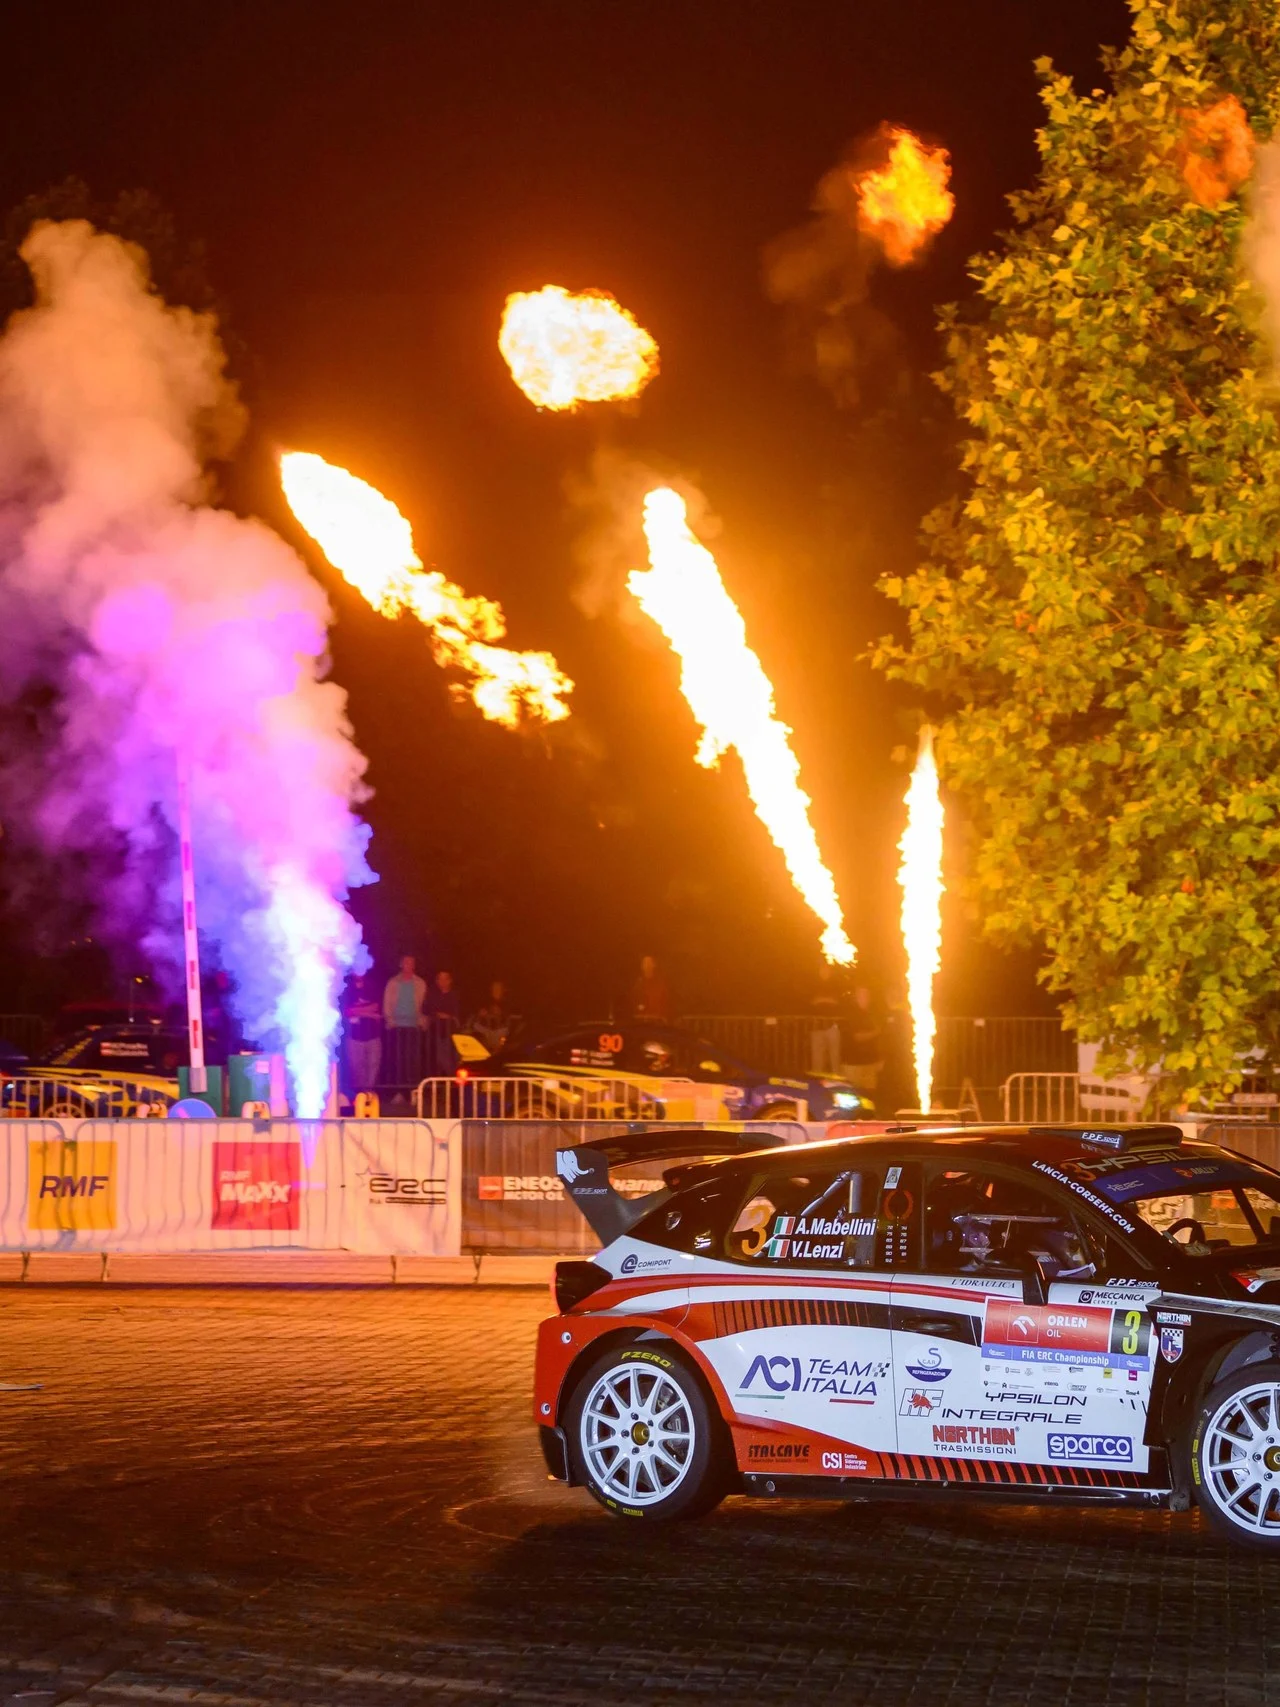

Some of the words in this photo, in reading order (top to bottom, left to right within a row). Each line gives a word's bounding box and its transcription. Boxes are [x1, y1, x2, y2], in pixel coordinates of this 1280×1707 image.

[599, 1033, 623, 1053] 90
[39, 1175, 109, 1199] RMF
[369, 1177, 446, 1194] ERC
[503, 1176, 565, 1191] ENEOS
[1031, 1160, 1136, 1234] LANCIA-CORSEHF.COM
[741, 1205, 771, 1256] 3
[795, 1218, 877, 1236] A.Mabellini
[792, 1241, 844, 1259] V.Lenzi
[637, 1259, 672, 1268] COMIPONT
[951, 1279, 1016, 1289] L'IDRAULICA
[1094, 1292, 1145, 1302] MECCANICA
[1047, 1315, 1088, 1328] ORLEN
[1046, 1328, 1062, 1338] OIL
[1122, 1310, 1142, 1355] 3
[1021, 1349, 1035, 1360] FIA
[1037, 1351, 1052, 1361] ERC
[1055, 1353, 1110, 1367] Championship
[739, 1355, 801, 1392] ACI
[809, 1359, 872, 1376] TEAM
[802, 1377, 877, 1396] ITALIA
[985, 1392, 1087, 1406] YPSILON
[942, 1408, 1083, 1425] INTEGRALE
[932, 1425, 1015, 1446] NORTHON
[934, 1444, 1017, 1455] TRASMISSIONI
[1050, 1435, 1130, 1458] sparco
[822, 1452, 842, 1469] CSI
